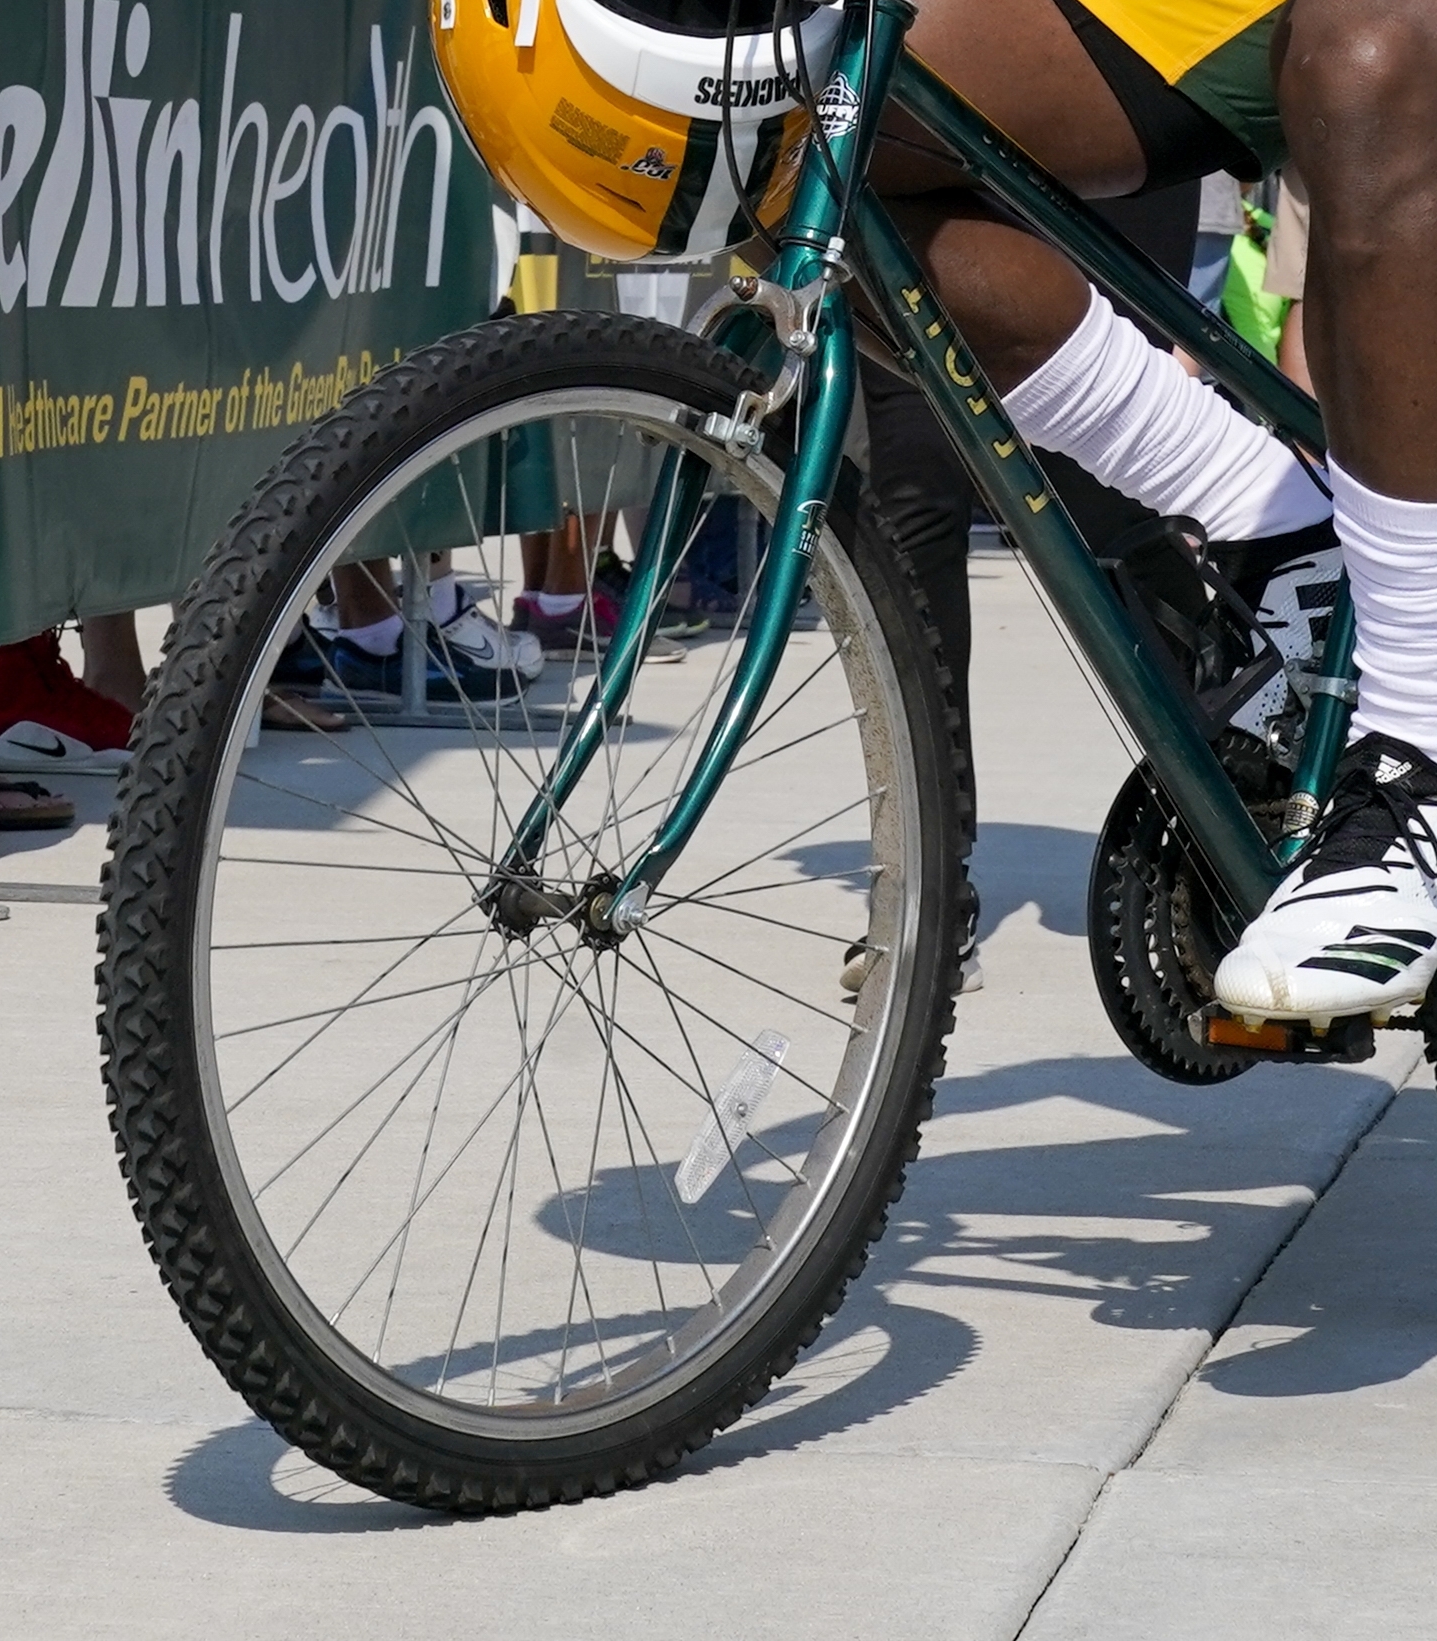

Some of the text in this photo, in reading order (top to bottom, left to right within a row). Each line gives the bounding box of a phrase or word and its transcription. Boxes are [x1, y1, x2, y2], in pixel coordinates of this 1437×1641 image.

[815, 104, 860, 122] UFFY
[117, 375, 223, 443] Partner
[224, 367, 251, 434] of
[252, 365, 285, 430] the
